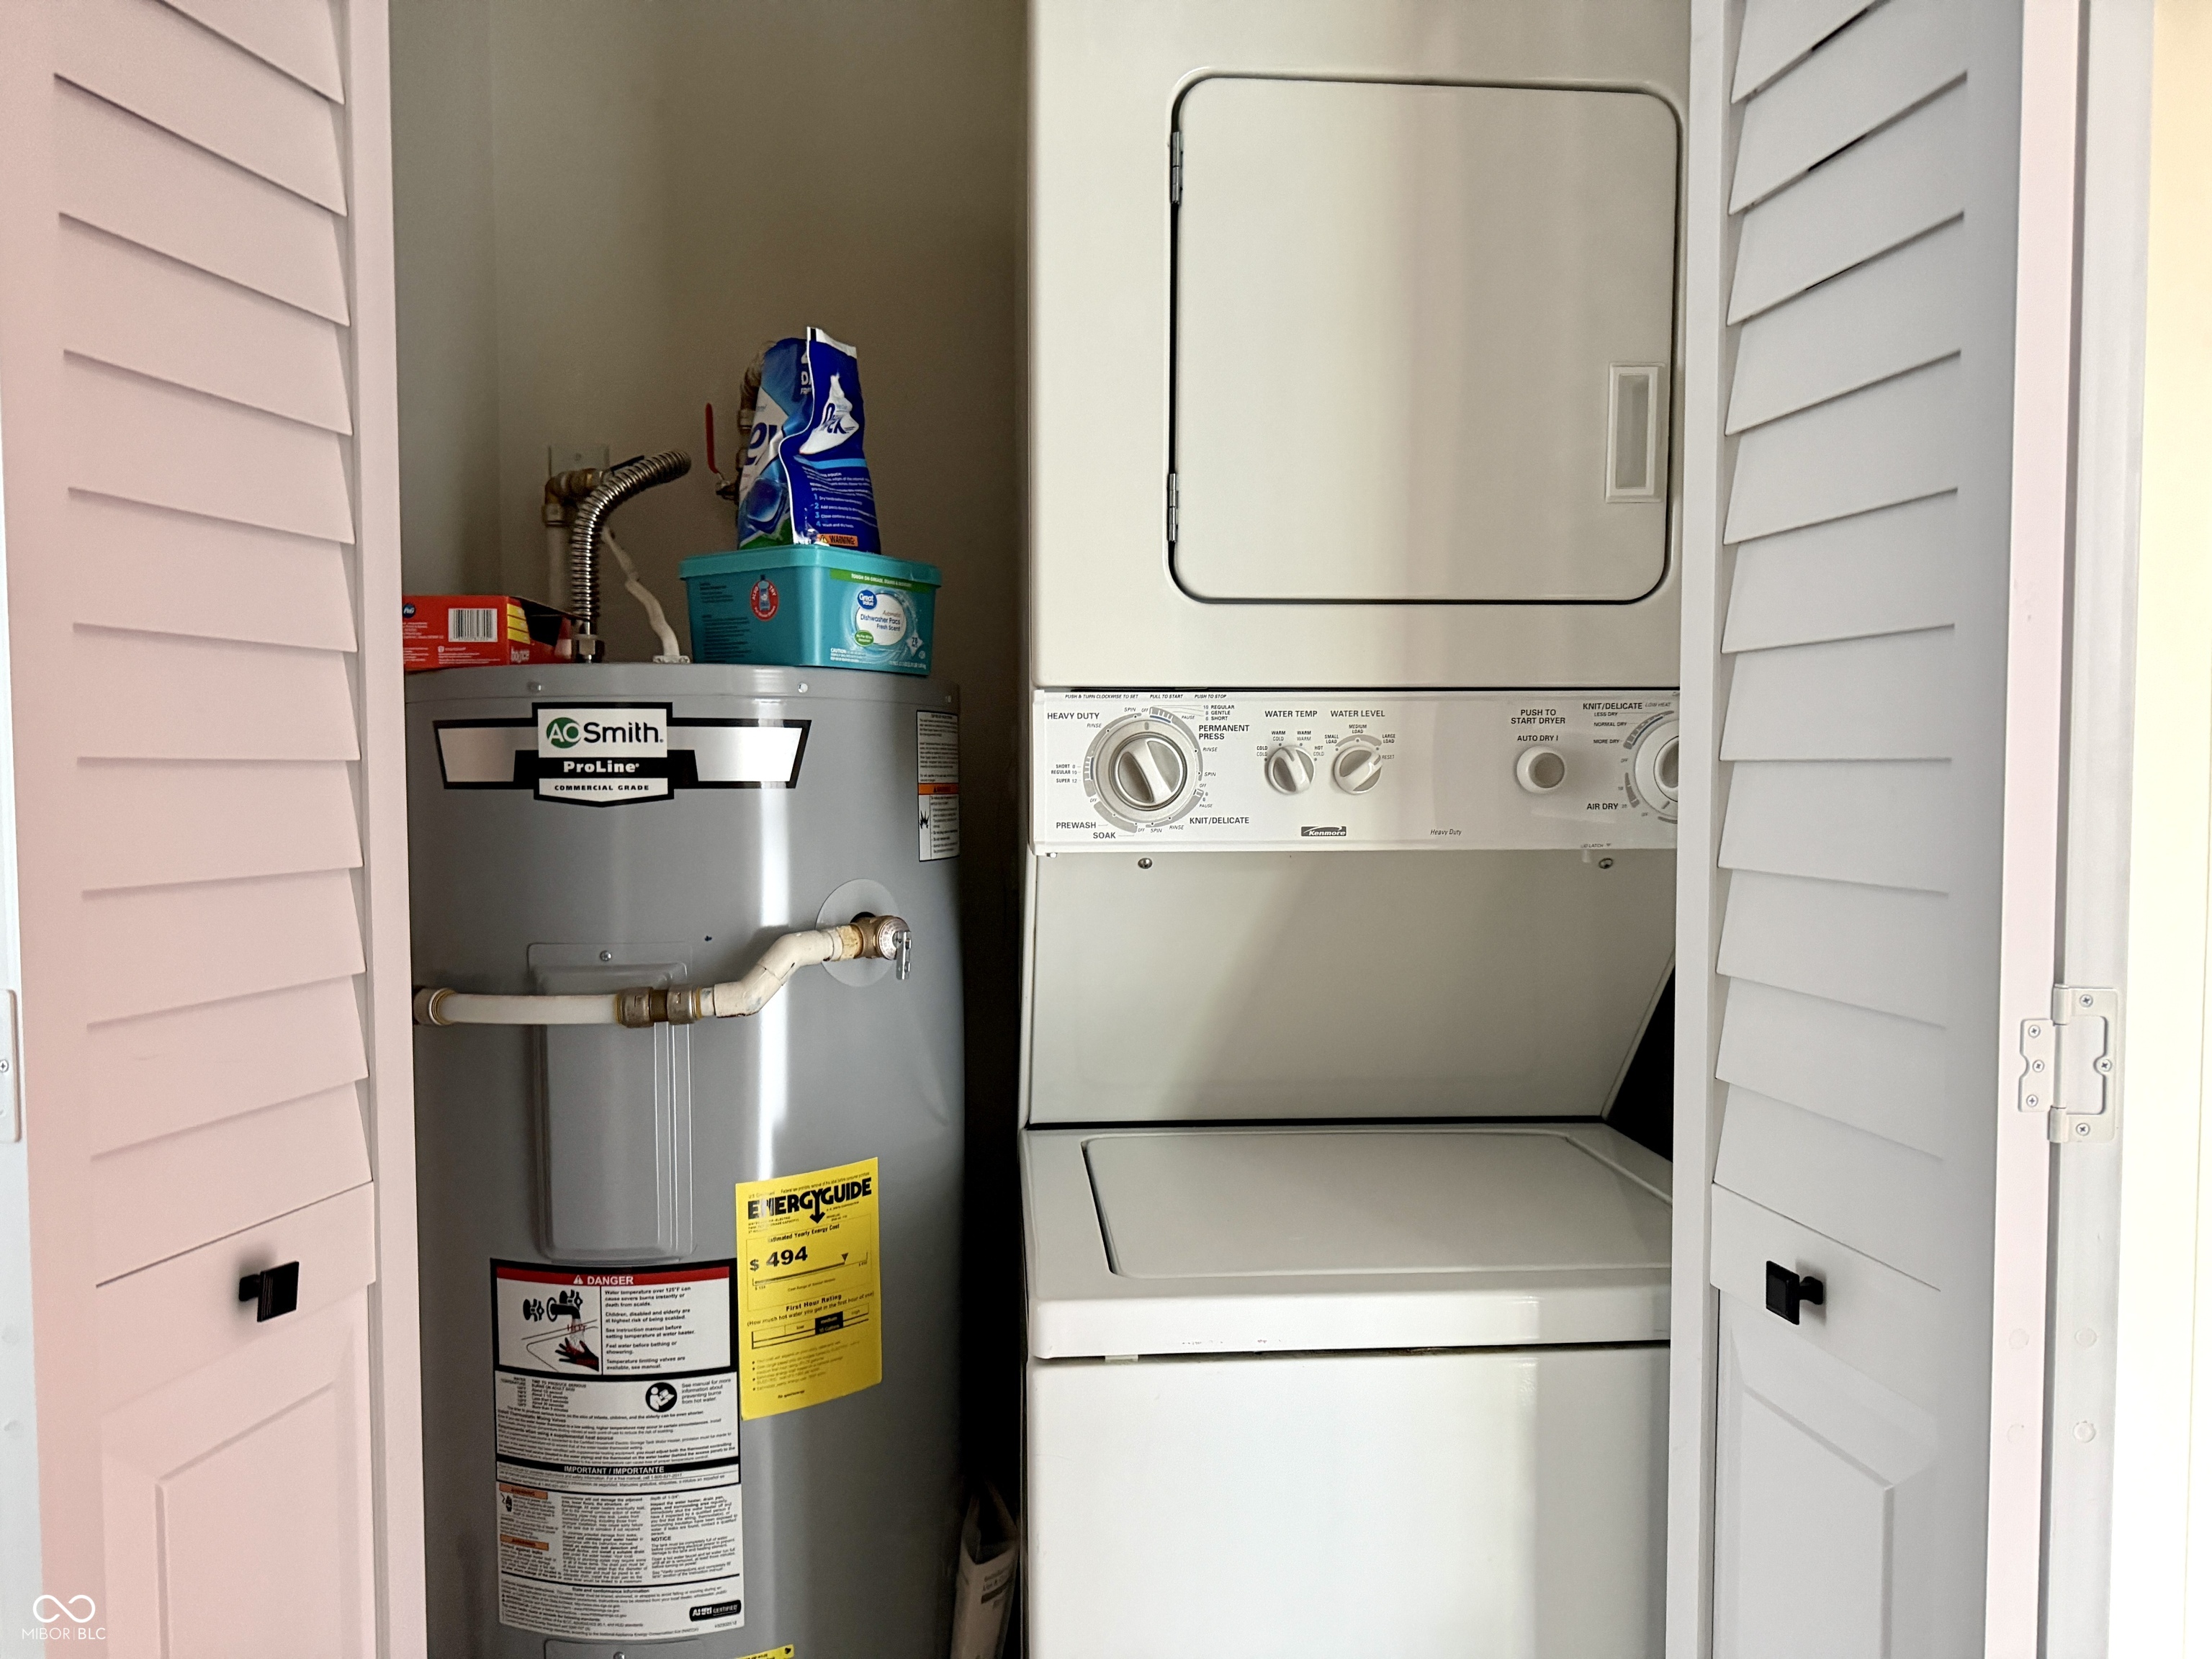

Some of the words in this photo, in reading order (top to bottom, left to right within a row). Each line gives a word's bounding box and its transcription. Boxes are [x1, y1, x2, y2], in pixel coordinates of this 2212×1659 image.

[859, 593, 874, 603] Great
[860, 614, 888, 624] Dishwasher
[795, 1231, 810, 1239] Yearly
[750, 1259, 760, 1272] $
[766, 1246, 808, 1267] 494
[587, 1275, 634, 1286] DANGER
[822, 1295, 842, 1303] Rating
[564, 1465, 607, 1475] IMPORTANT
[613, 1466, 665, 1475] IMPORTANTE
